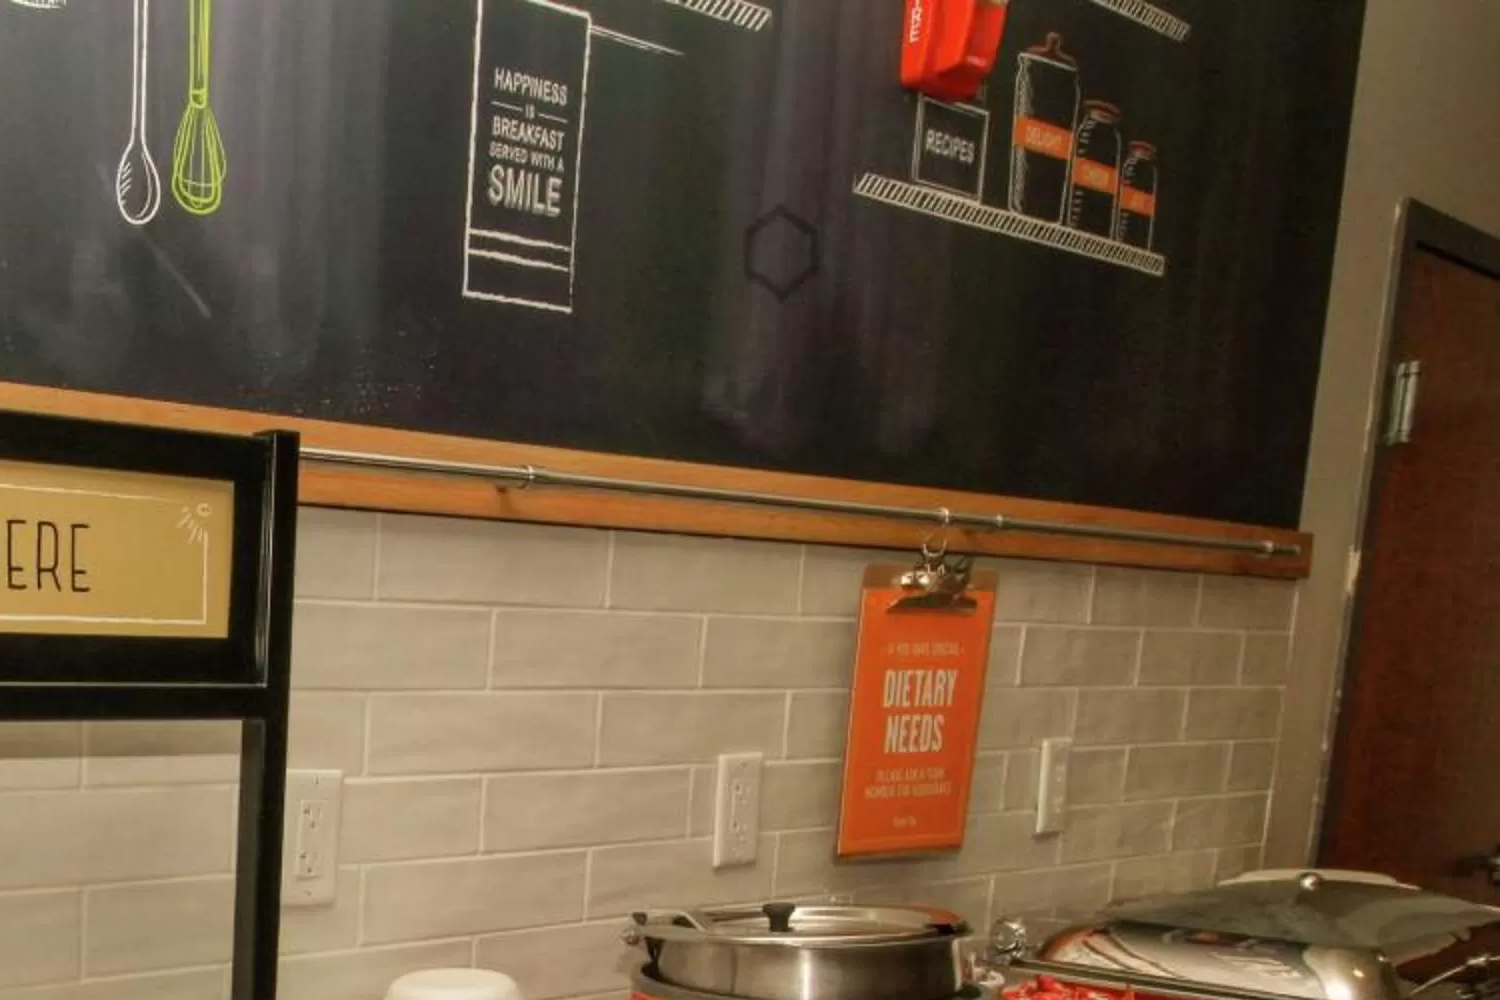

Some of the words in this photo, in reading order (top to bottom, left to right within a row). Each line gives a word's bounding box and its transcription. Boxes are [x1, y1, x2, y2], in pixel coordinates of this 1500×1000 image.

[493, 67, 568, 107] HAPPINESS
[525, 103, 536, 119] IS
[492, 115, 565, 152] BREAKFAST
[925, 129, 975, 165] RECIPES
[488, 141, 528, 164] SERVED
[530, 151, 556, 172] WITH
[556, 156, 565, 173] A
[487, 163, 564, 218] SMILE
[882, 669, 959, 709] DIETARY
[884, 714, 945, 754] NEEDS
